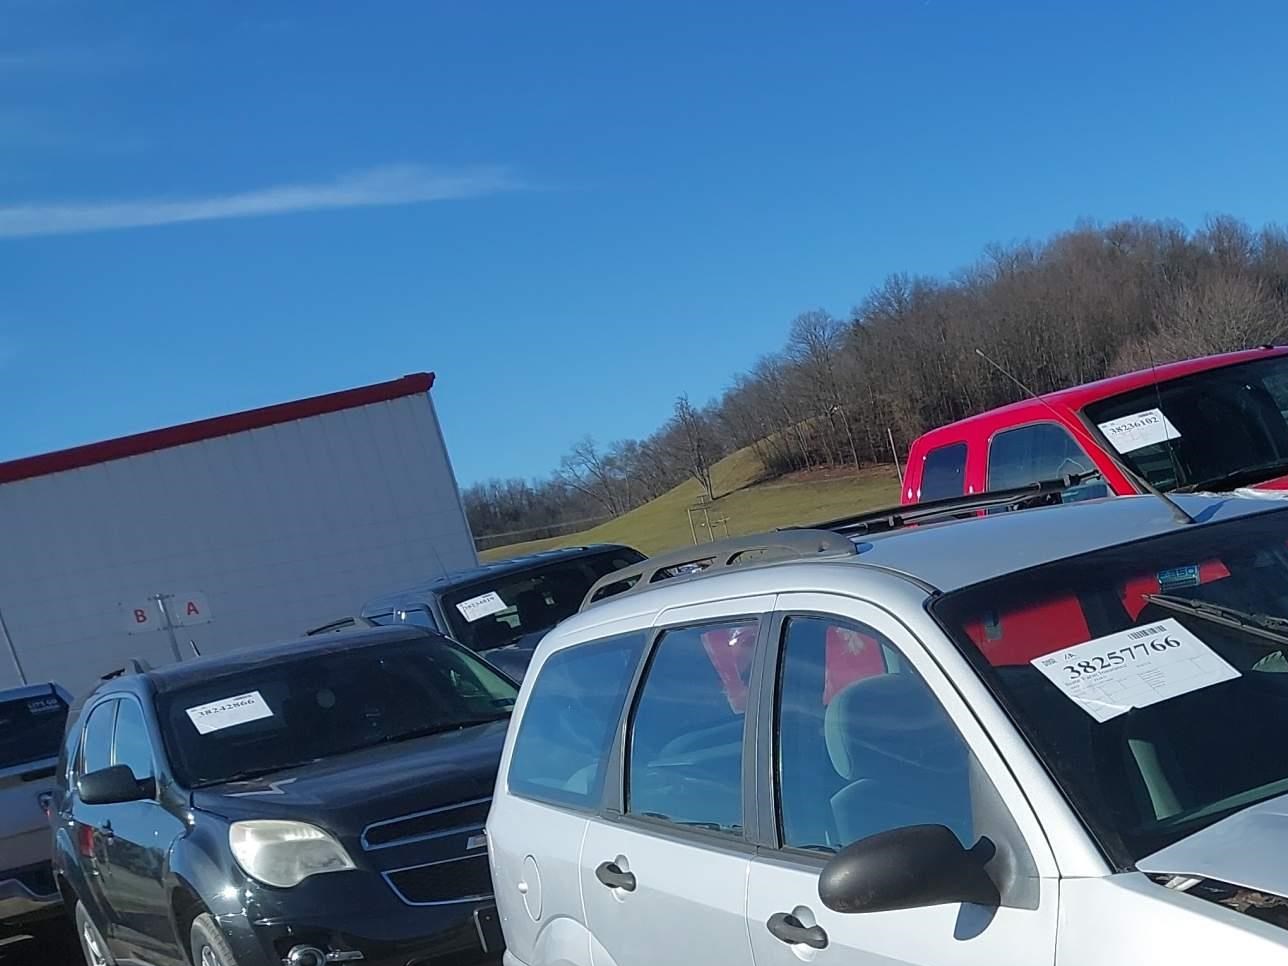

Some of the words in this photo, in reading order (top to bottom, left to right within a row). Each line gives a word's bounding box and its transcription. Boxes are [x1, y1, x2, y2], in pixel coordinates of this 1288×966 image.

[1109, 416, 1160, 435] 38236102
[133, 608, 148, 624] B
[186, 601, 200, 616] A
[1063, 634, 1181, 680] 38257766
